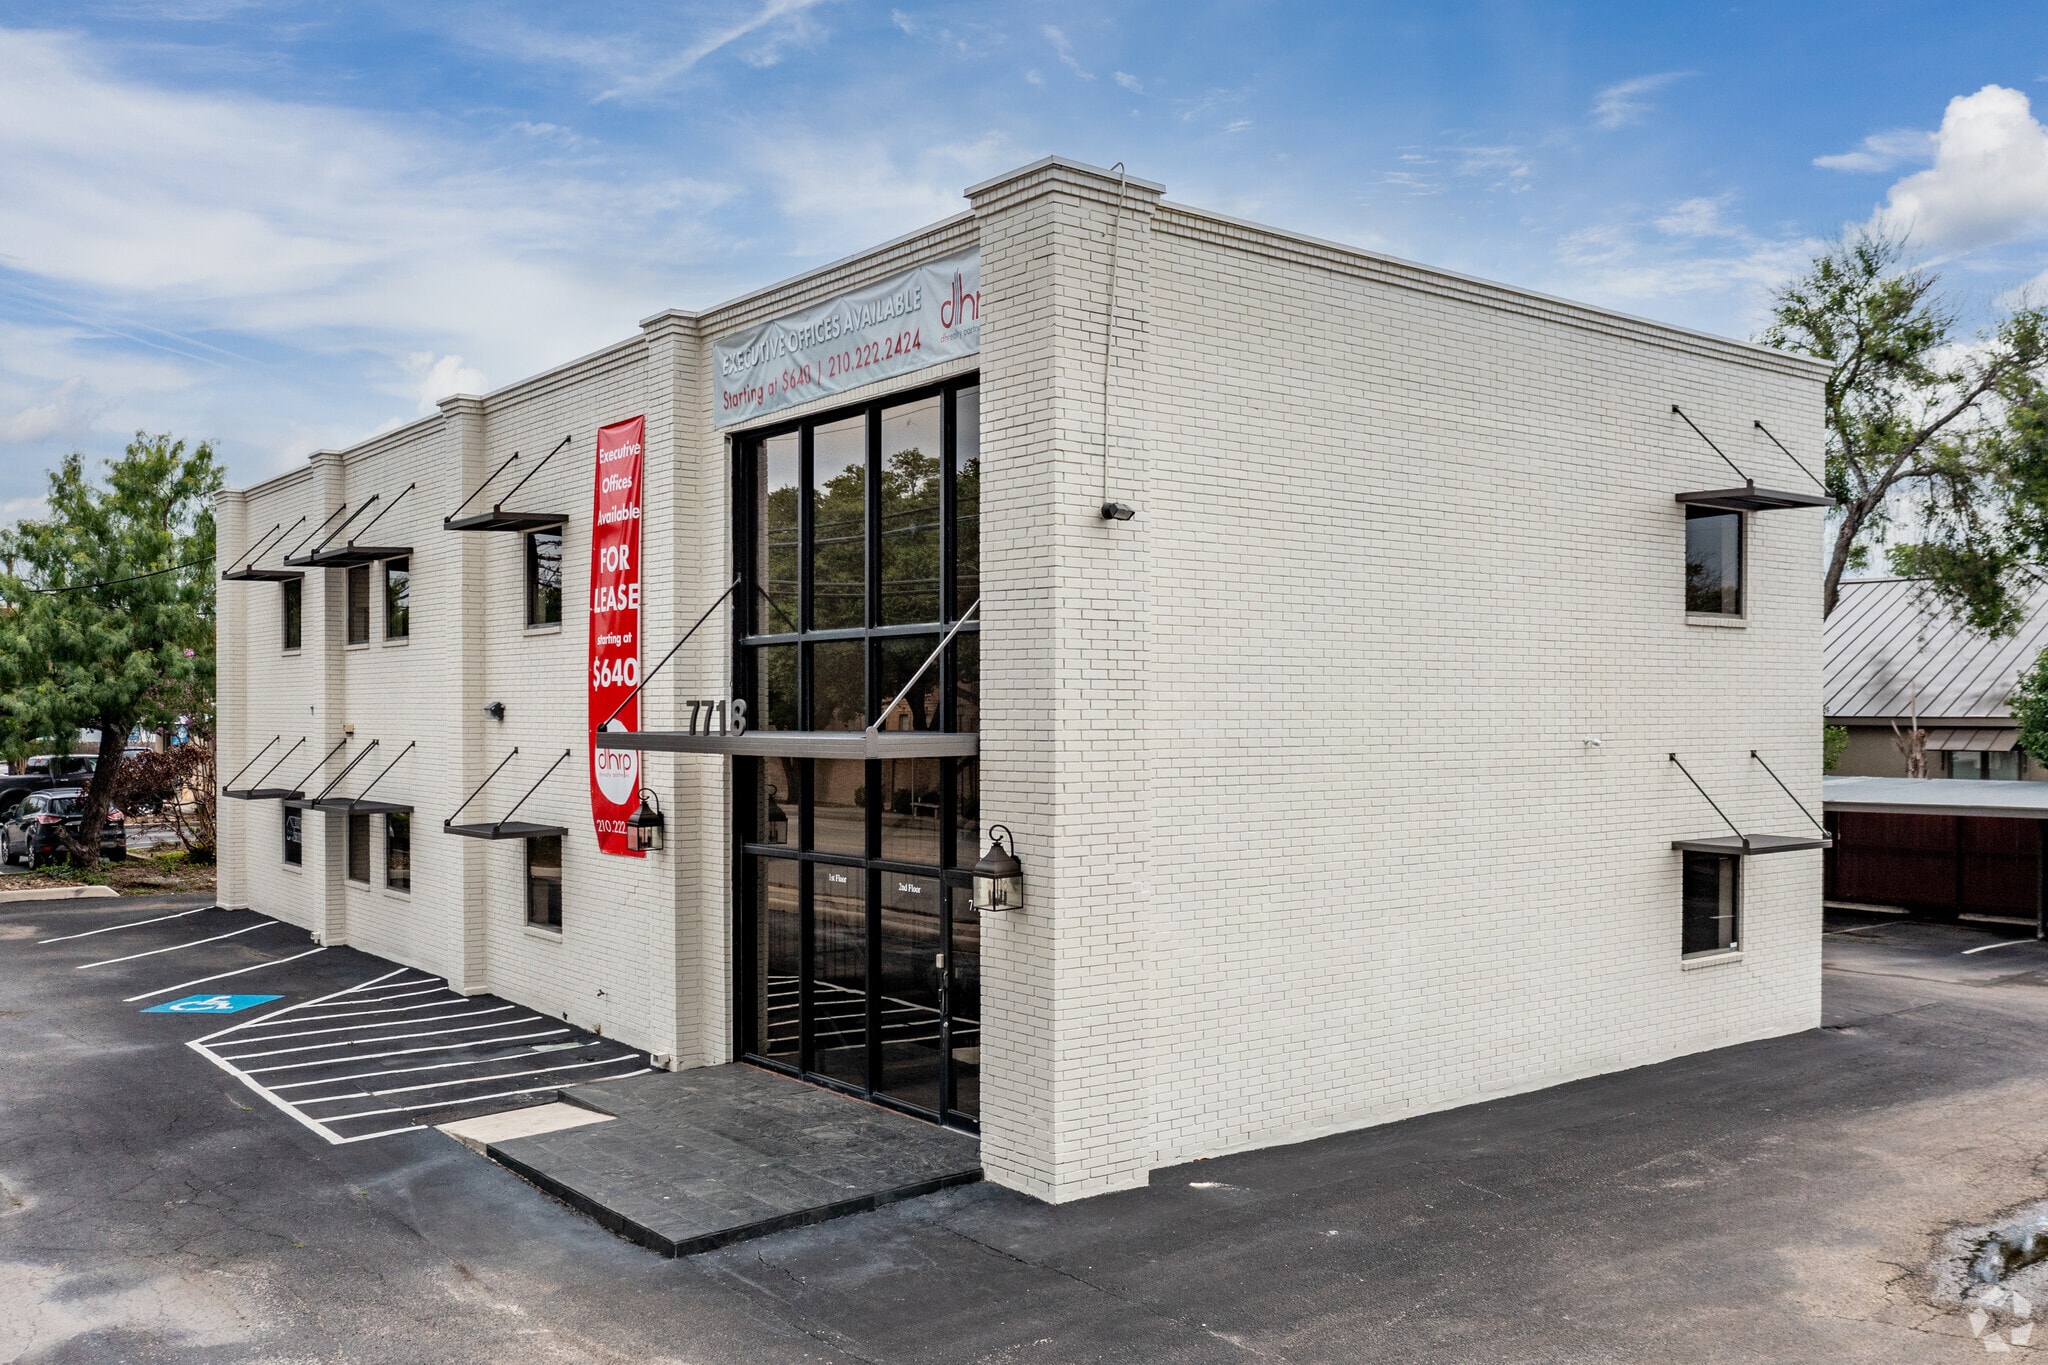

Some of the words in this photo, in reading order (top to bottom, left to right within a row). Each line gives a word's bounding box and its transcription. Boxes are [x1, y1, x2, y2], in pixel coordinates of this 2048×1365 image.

[940, 273, 981, 329] dhr
[723, 334, 785, 377] EXECUTIVE
[788, 314, 842, 353] OFFICES
[843, 285, 922, 336] AVAILABLE
[723, 384, 764, 411] Starting
[767, 377, 778, 396] at
[781, 363, 811, 392] $640
[828, 328, 921, 378] 210.222.2424
[599, 440, 641, 464] Executive
[602, 474, 632, 493] Offices
[597, 502, 640, 527] Available
[600, 544, 630, 574] FOR
[594, 582, 640, 614] LEASE
[597, 631, 621, 647] starting
[623, 632, 632, 643] at
[593, 656, 638, 692] $640
[686, 698, 748, 737] 7718
[596, 819, 628, 835] 210.222.
[835, 874, 847, 883] Floor
[898, 882, 908, 892] 2nd
[908, 883, 921, 894] Floor
